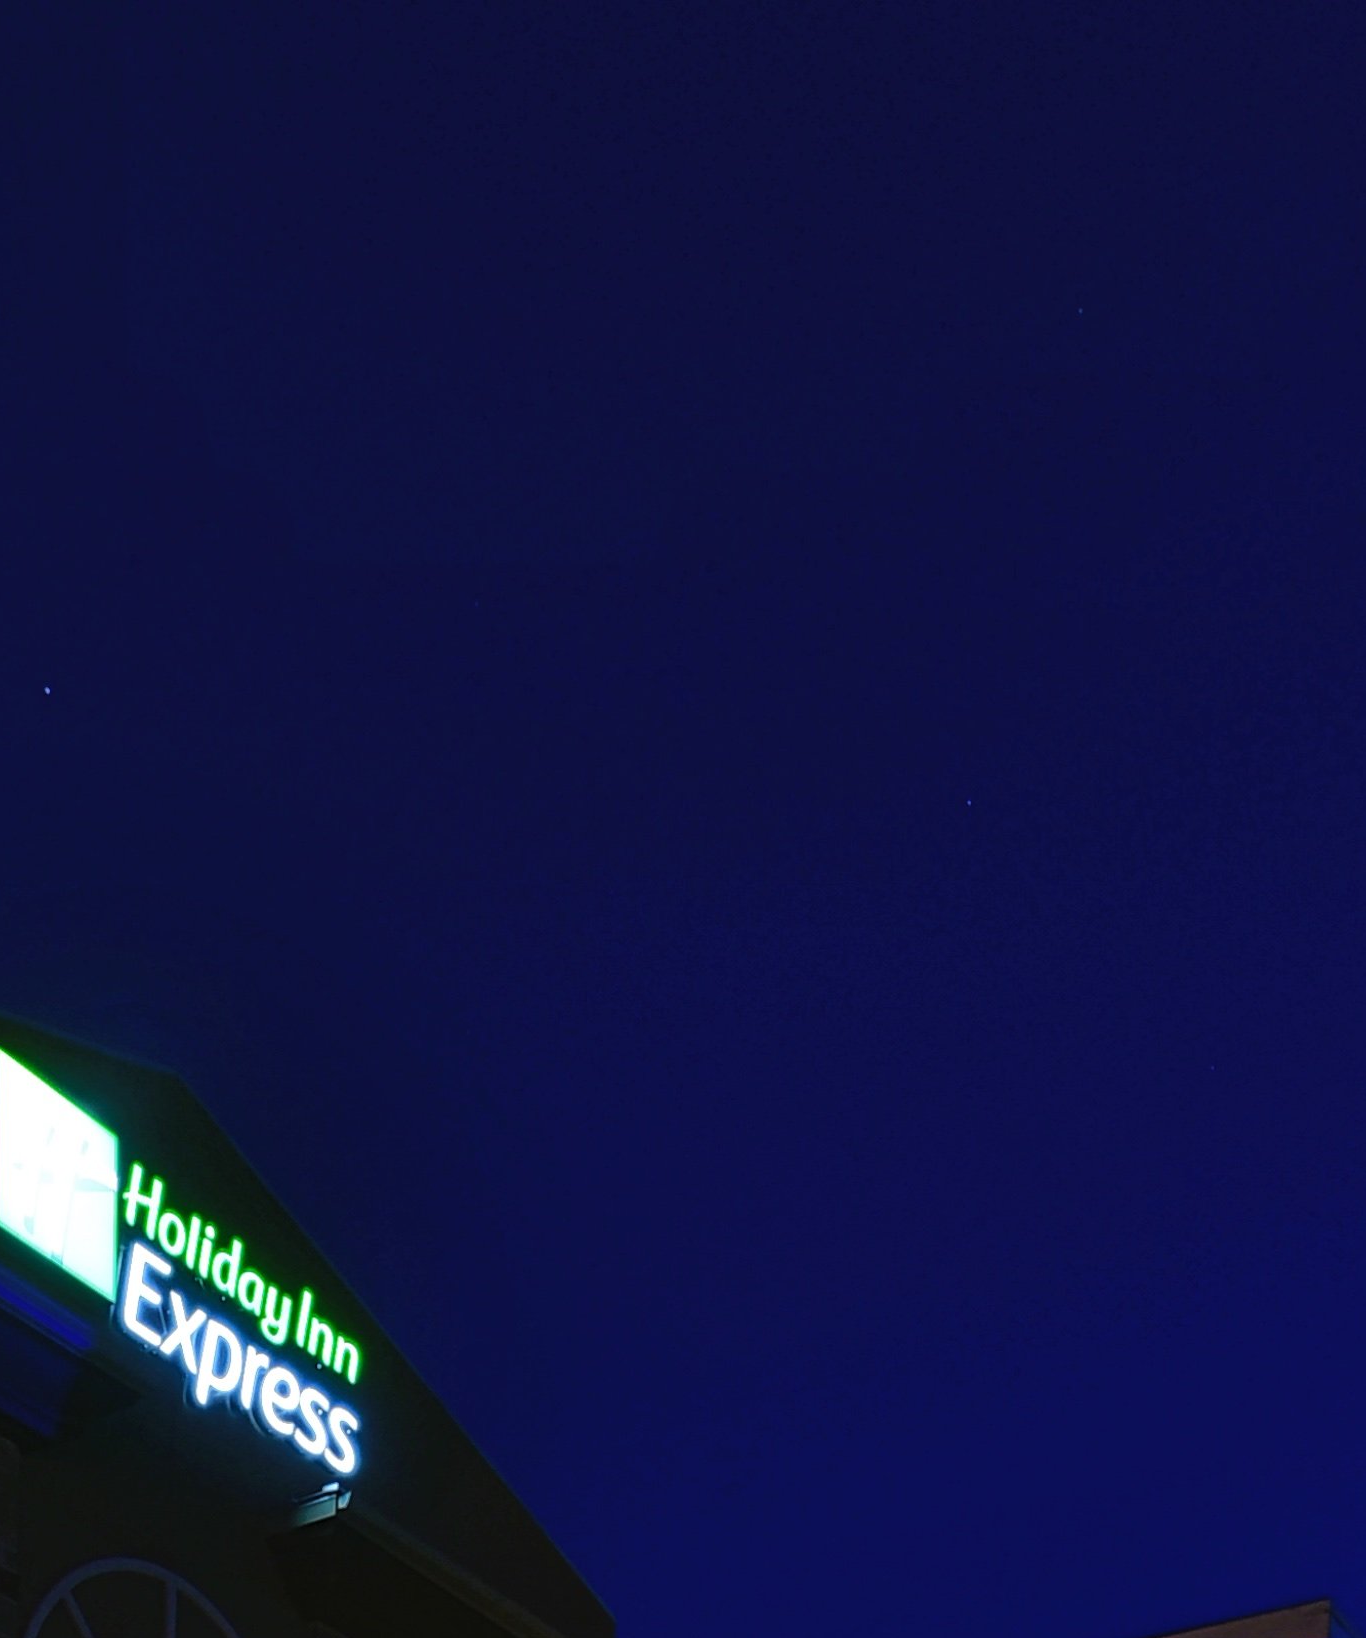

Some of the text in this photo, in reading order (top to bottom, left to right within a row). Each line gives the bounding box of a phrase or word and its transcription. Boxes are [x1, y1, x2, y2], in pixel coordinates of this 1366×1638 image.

[122, 1242, 360, 1475] Express
[123, 1162, 361, 1385] Holiday Inn
